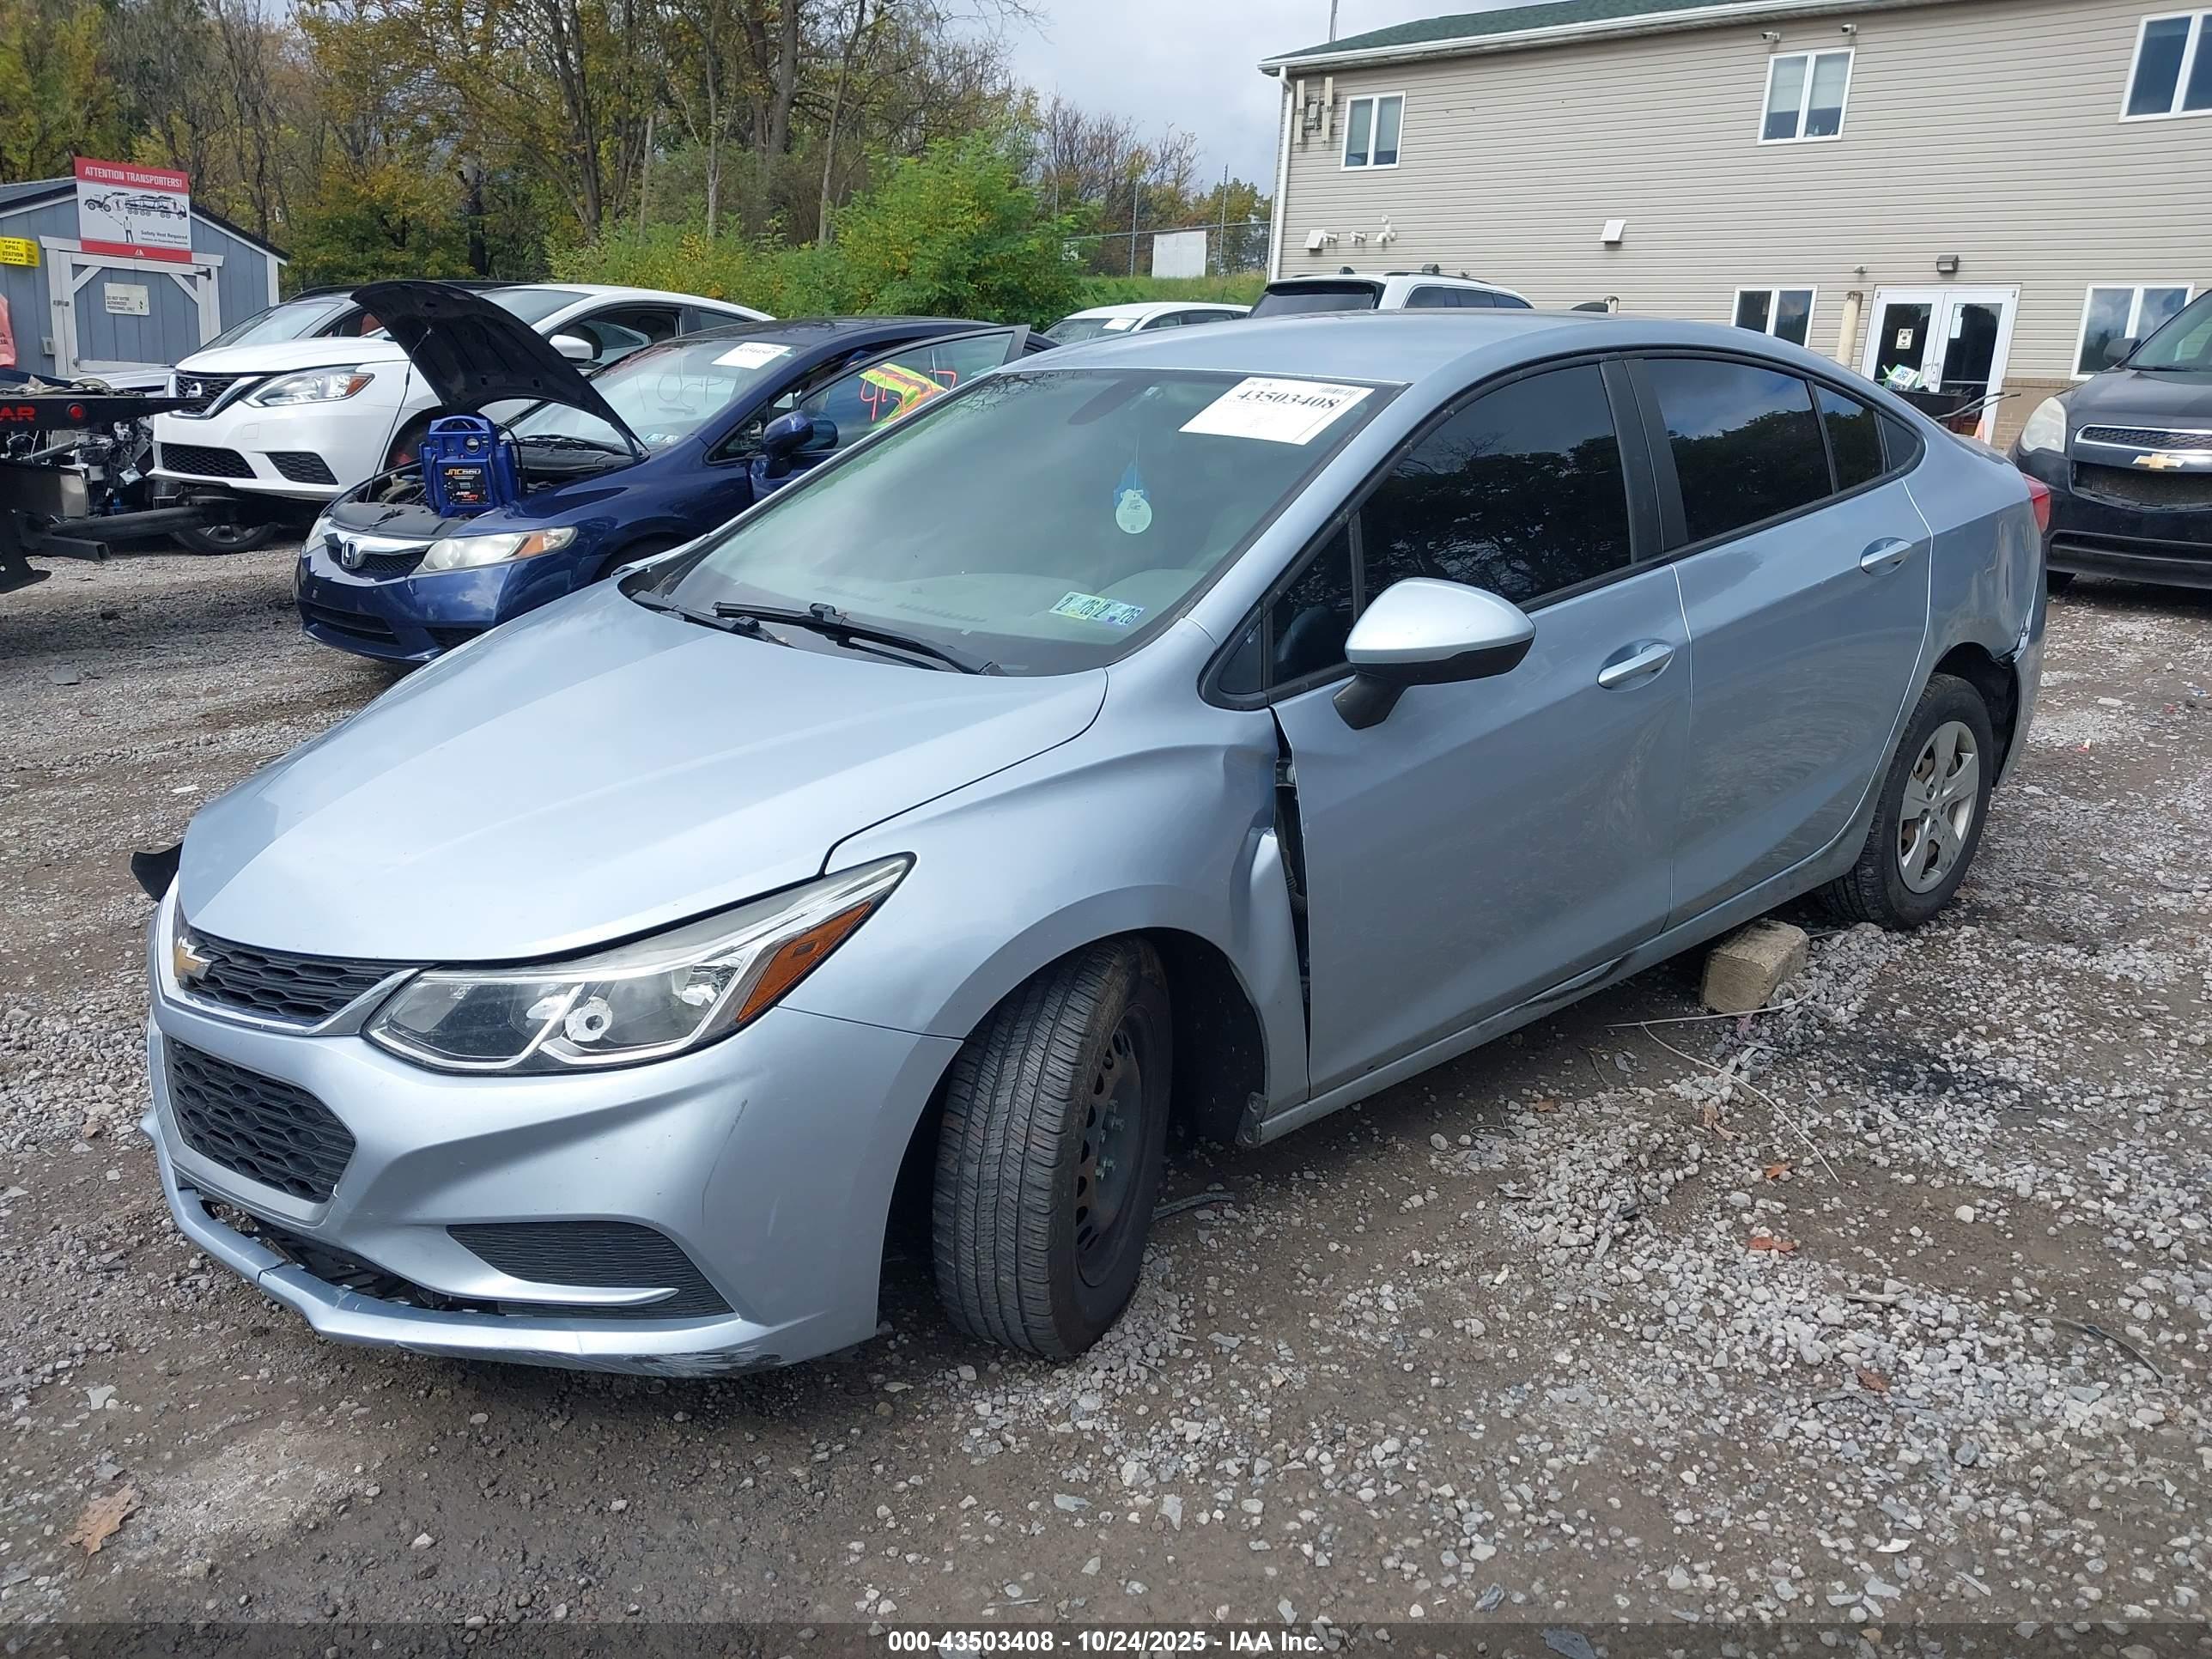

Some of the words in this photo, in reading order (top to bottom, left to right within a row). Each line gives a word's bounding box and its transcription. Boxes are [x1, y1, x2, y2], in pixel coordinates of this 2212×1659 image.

[85, 166, 125, 180] ATTENTION
[126, 172, 183, 188] TRANSPORTERS!
[1237, 390, 1340, 409] 43503408
[1056, 597, 1073, 611] 2
[1093, 603, 1112, 618] 2
